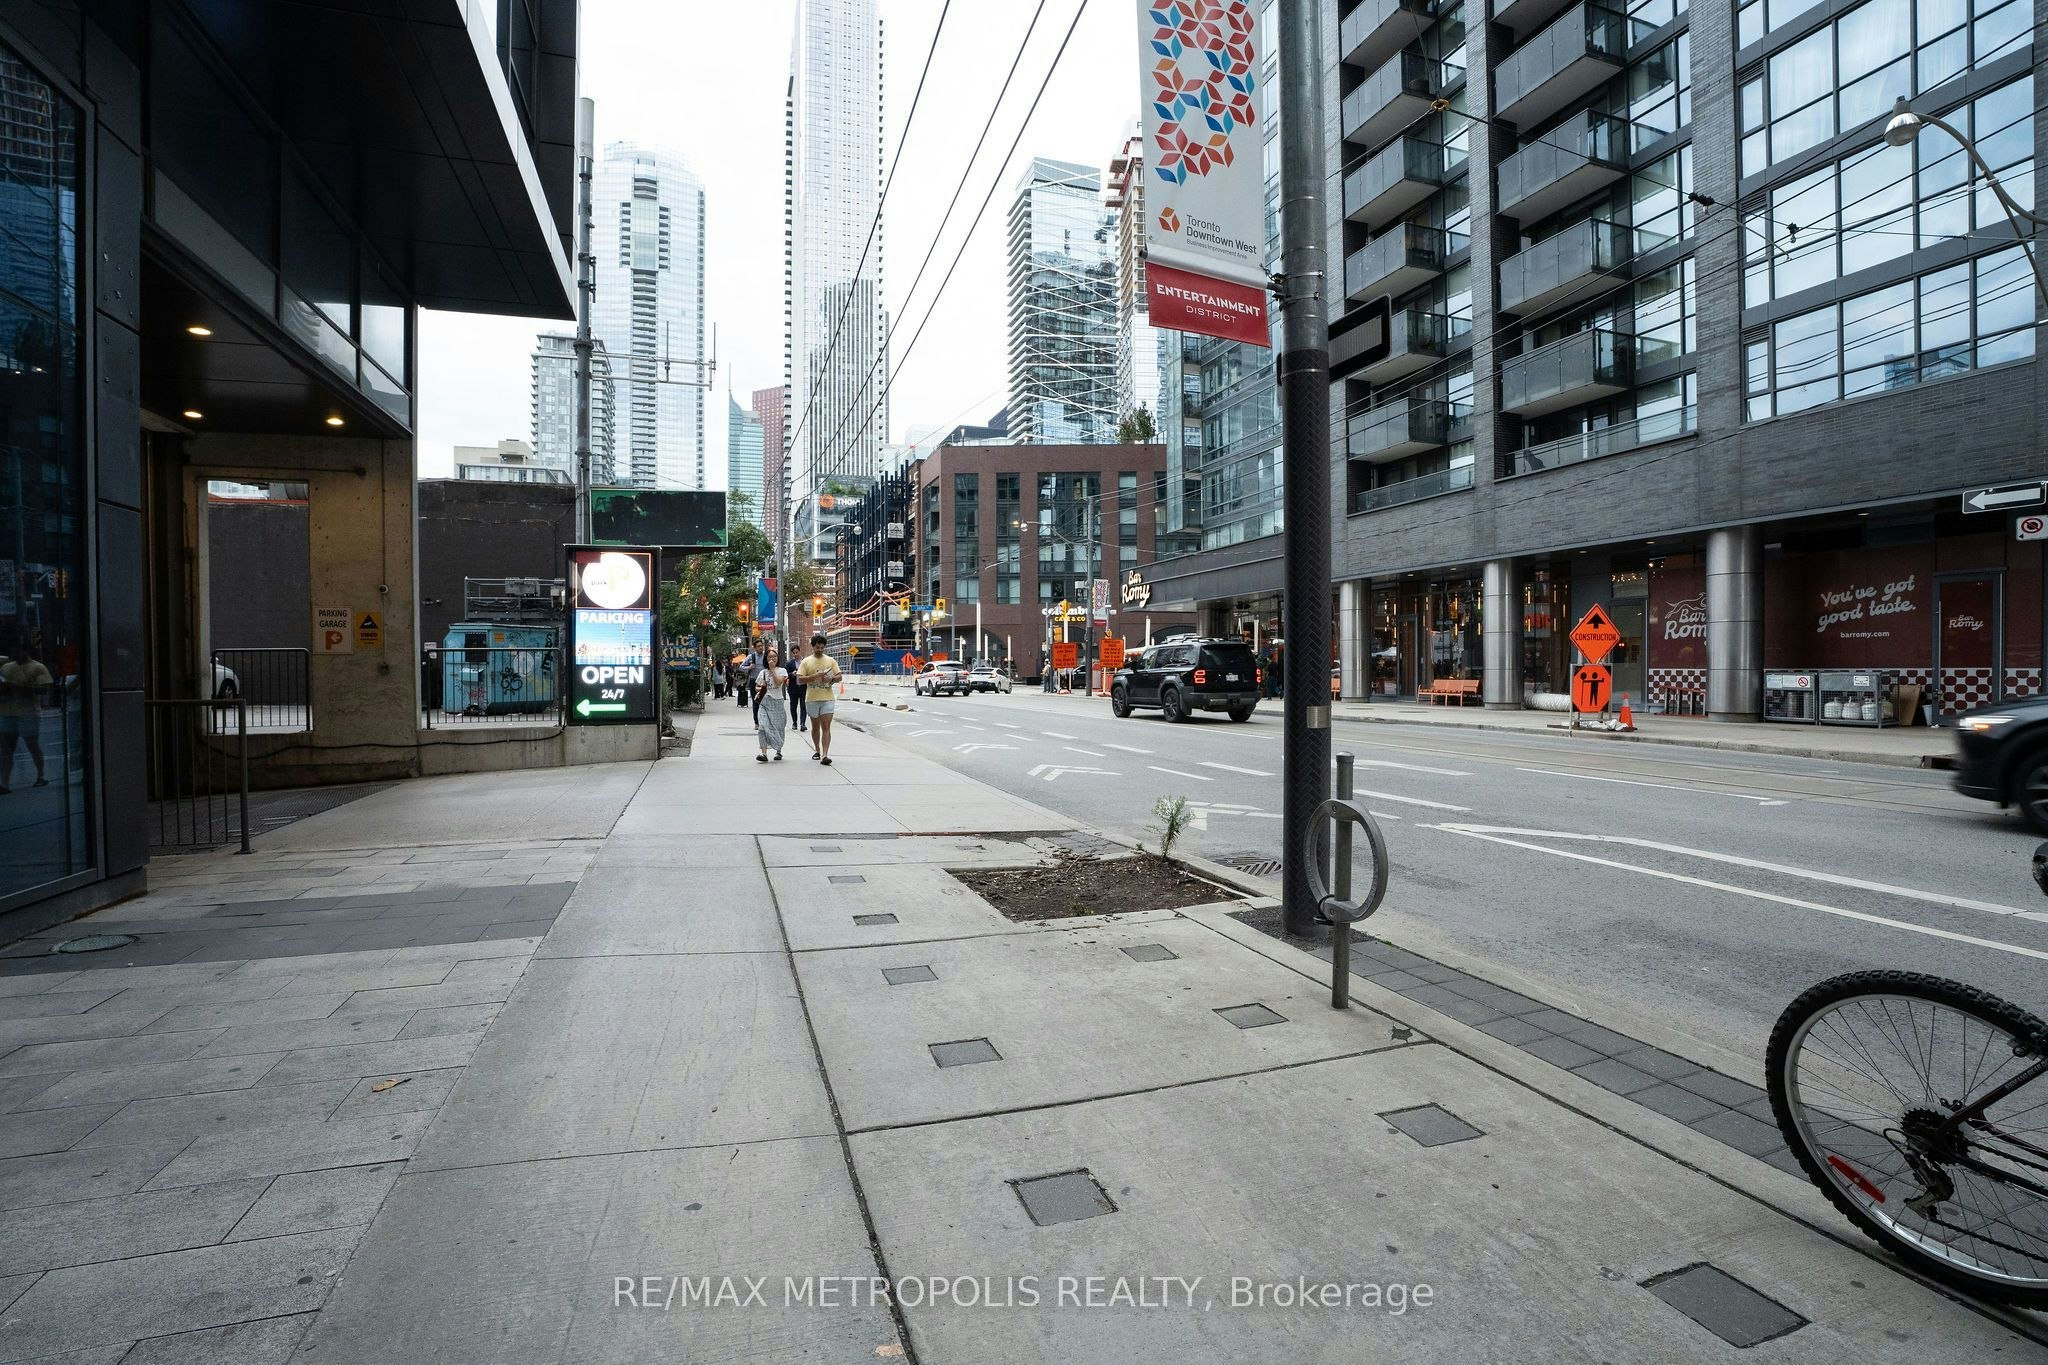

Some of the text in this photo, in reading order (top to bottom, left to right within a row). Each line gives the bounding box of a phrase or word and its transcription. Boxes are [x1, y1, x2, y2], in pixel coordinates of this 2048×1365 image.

[1187, 214, 1221, 233] Toronto
[1186, 226, 1257, 255] Downtown West
[1156, 283, 1261, 317] ENTERTAINMENT
[1186, 305, 1237, 323] DISTRICT
[1128, 570, 1142, 585] Bar
[1121, 584, 1150, 608] Romy
[1820, 574, 1917, 608] You've got
[318, 609, 348, 618] PARKING
[579, 612, 645, 624] PARKING
[1679, 608, 1707, 623] Bar
[1816, 595, 1917, 633] good taste.
[319, 620, 348, 628] GARAGE
[1664, 620, 1707, 640] Rom
[1948, 619, 1985, 631] Romy
[1574, 632, 1617, 642] CONSTRUCTION
[1839, 630, 1891, 639] barromy.com
[581, 665, 645, 685] OPEN
[601, 688, 625, 700] 24/7
